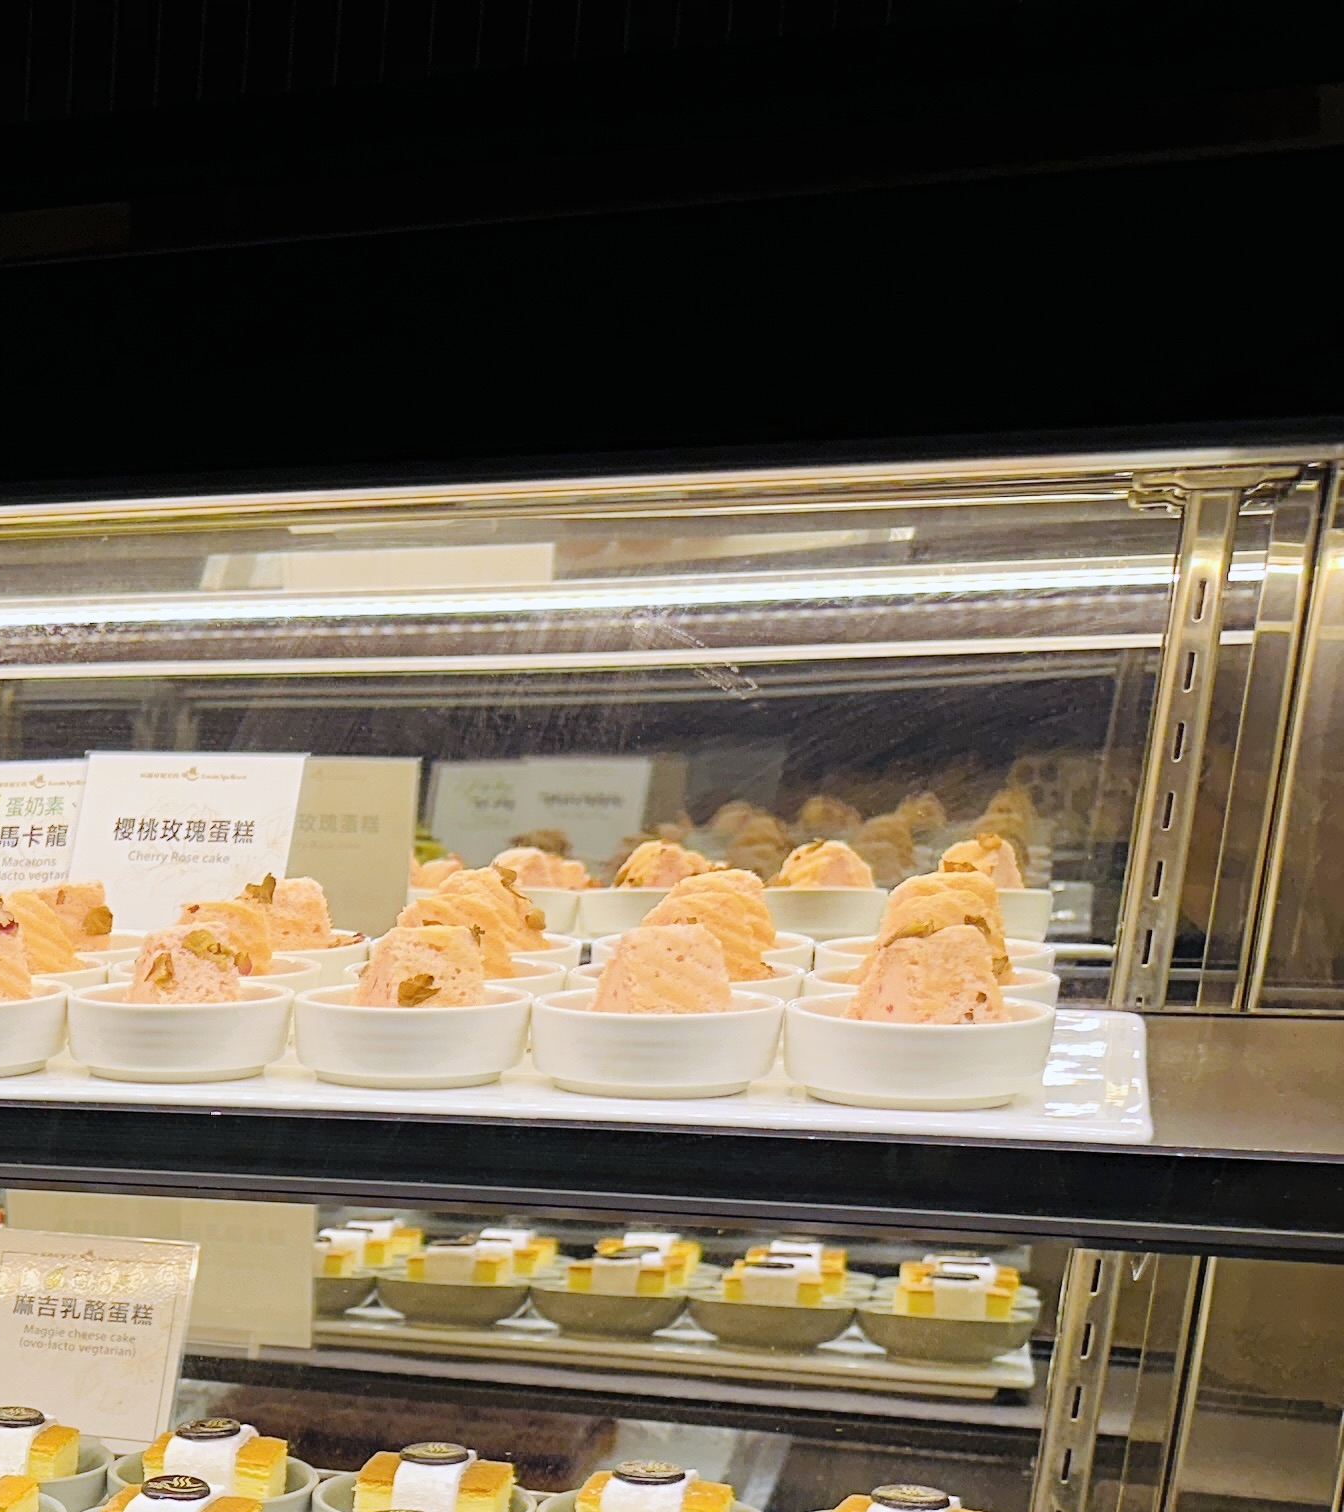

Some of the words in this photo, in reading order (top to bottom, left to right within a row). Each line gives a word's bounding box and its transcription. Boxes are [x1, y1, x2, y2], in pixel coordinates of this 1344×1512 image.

[6, 796, 64, 817] 蛋奶素
[112, 816, 255, 844] 櫻桃玫瑰蛋糕
[1, 857, 57, 868] Macarons
[127, 850, 168, 865] Cherry
[171, 851, 200, 864] Rose
[202, 852, 230, 864] cake
[12, 1294, 154, 1326] 麻吉乳酪蛋糕
[23, 1324, 65, 1338] Maggie
[67, 1328, 107, 1342] cheese
[110, 1331, 136, 1345] cake
